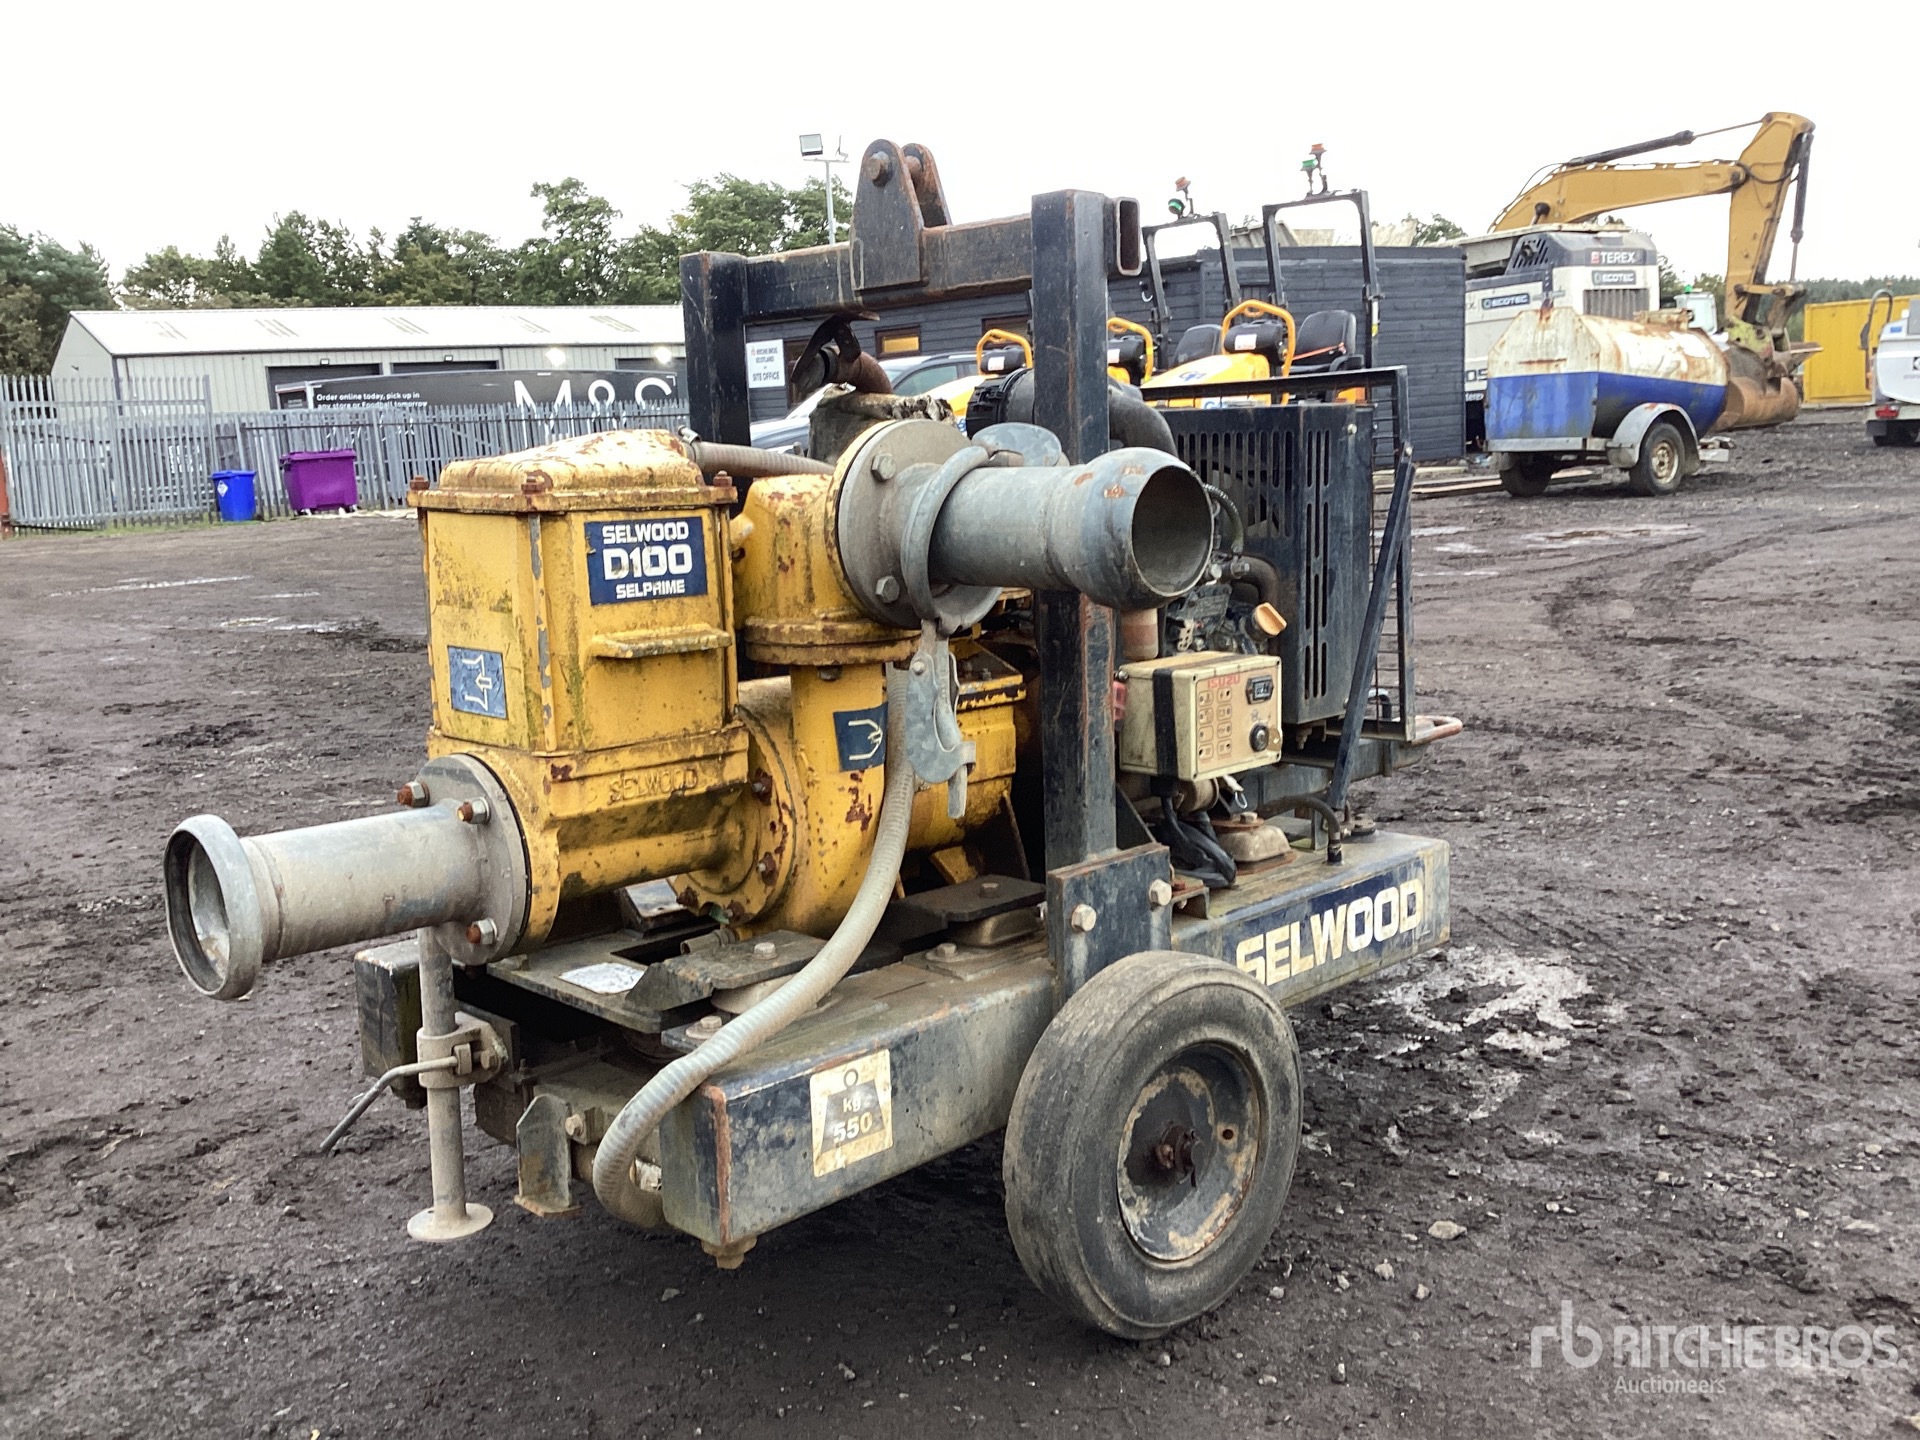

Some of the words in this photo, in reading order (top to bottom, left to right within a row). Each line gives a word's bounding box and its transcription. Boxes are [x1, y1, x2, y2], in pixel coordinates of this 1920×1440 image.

[1600, 251, 1636, 264] TEREX
[1600, 272, 1635, 283] ECOTEC
[762, 370, 780, 381] OFFICE
[316, 393, 338, 402] Order
[339, 392, 361, 401] online
[363, 391, 385, 402] today,
[386, 391, 401, 400] pick
[402, 392, 411, 400] up
[412, 391, 420, 399] in
[332, 401, 351, 409] store
[394, 400, 428, 408] tomorrow
[602, 521, 689, 545] SELWOOD
[602, 543, 693, 580] D100
[615, 579, 686, 600] SELPRIME
[1208, 673, 1240, 689] ISUZU
[609, 767, 699, 802] SELWOOD
[1235, 878, 1424, 987] SELWOOD
[833, 1111, 873, 1143] 550
